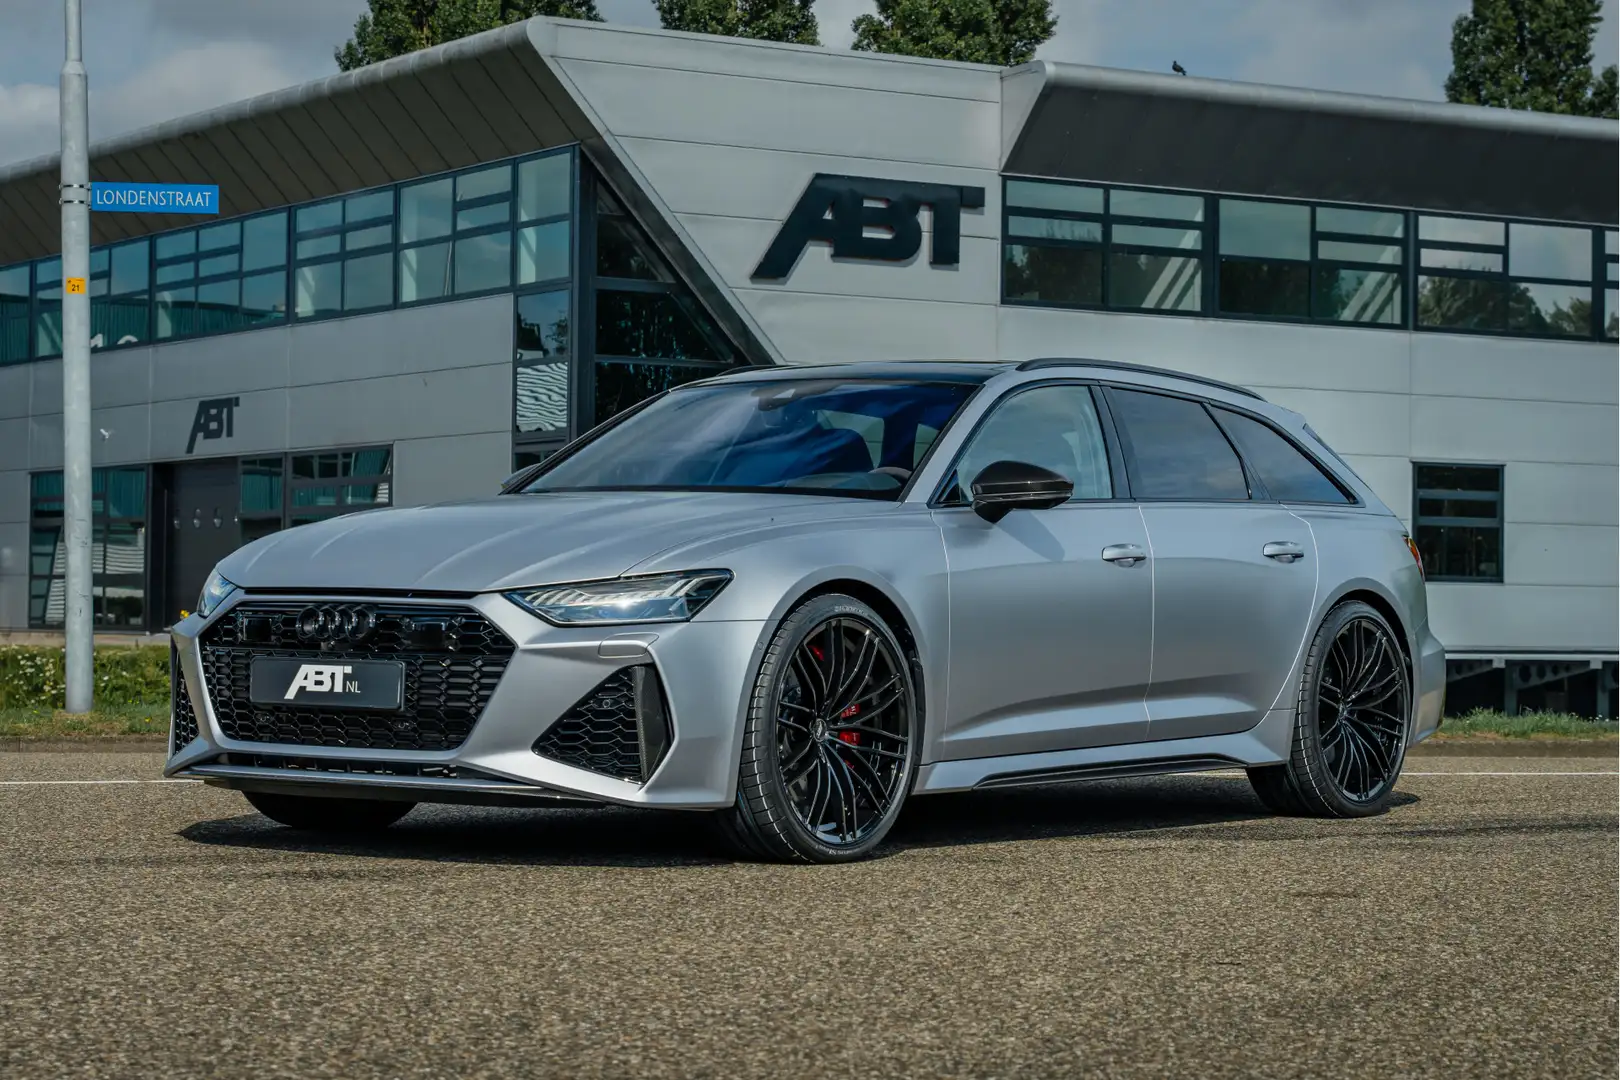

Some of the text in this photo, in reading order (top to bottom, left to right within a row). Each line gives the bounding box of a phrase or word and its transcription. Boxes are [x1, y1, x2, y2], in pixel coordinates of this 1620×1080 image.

[96, 189, 212, 206] LONDENSTRAAT
[750, 172, 985, 280] ABT
[71, 283, 80, 292] 21
[185, 396, 240, 454] ABT
[284, 664, 361, 700] ABT NL
